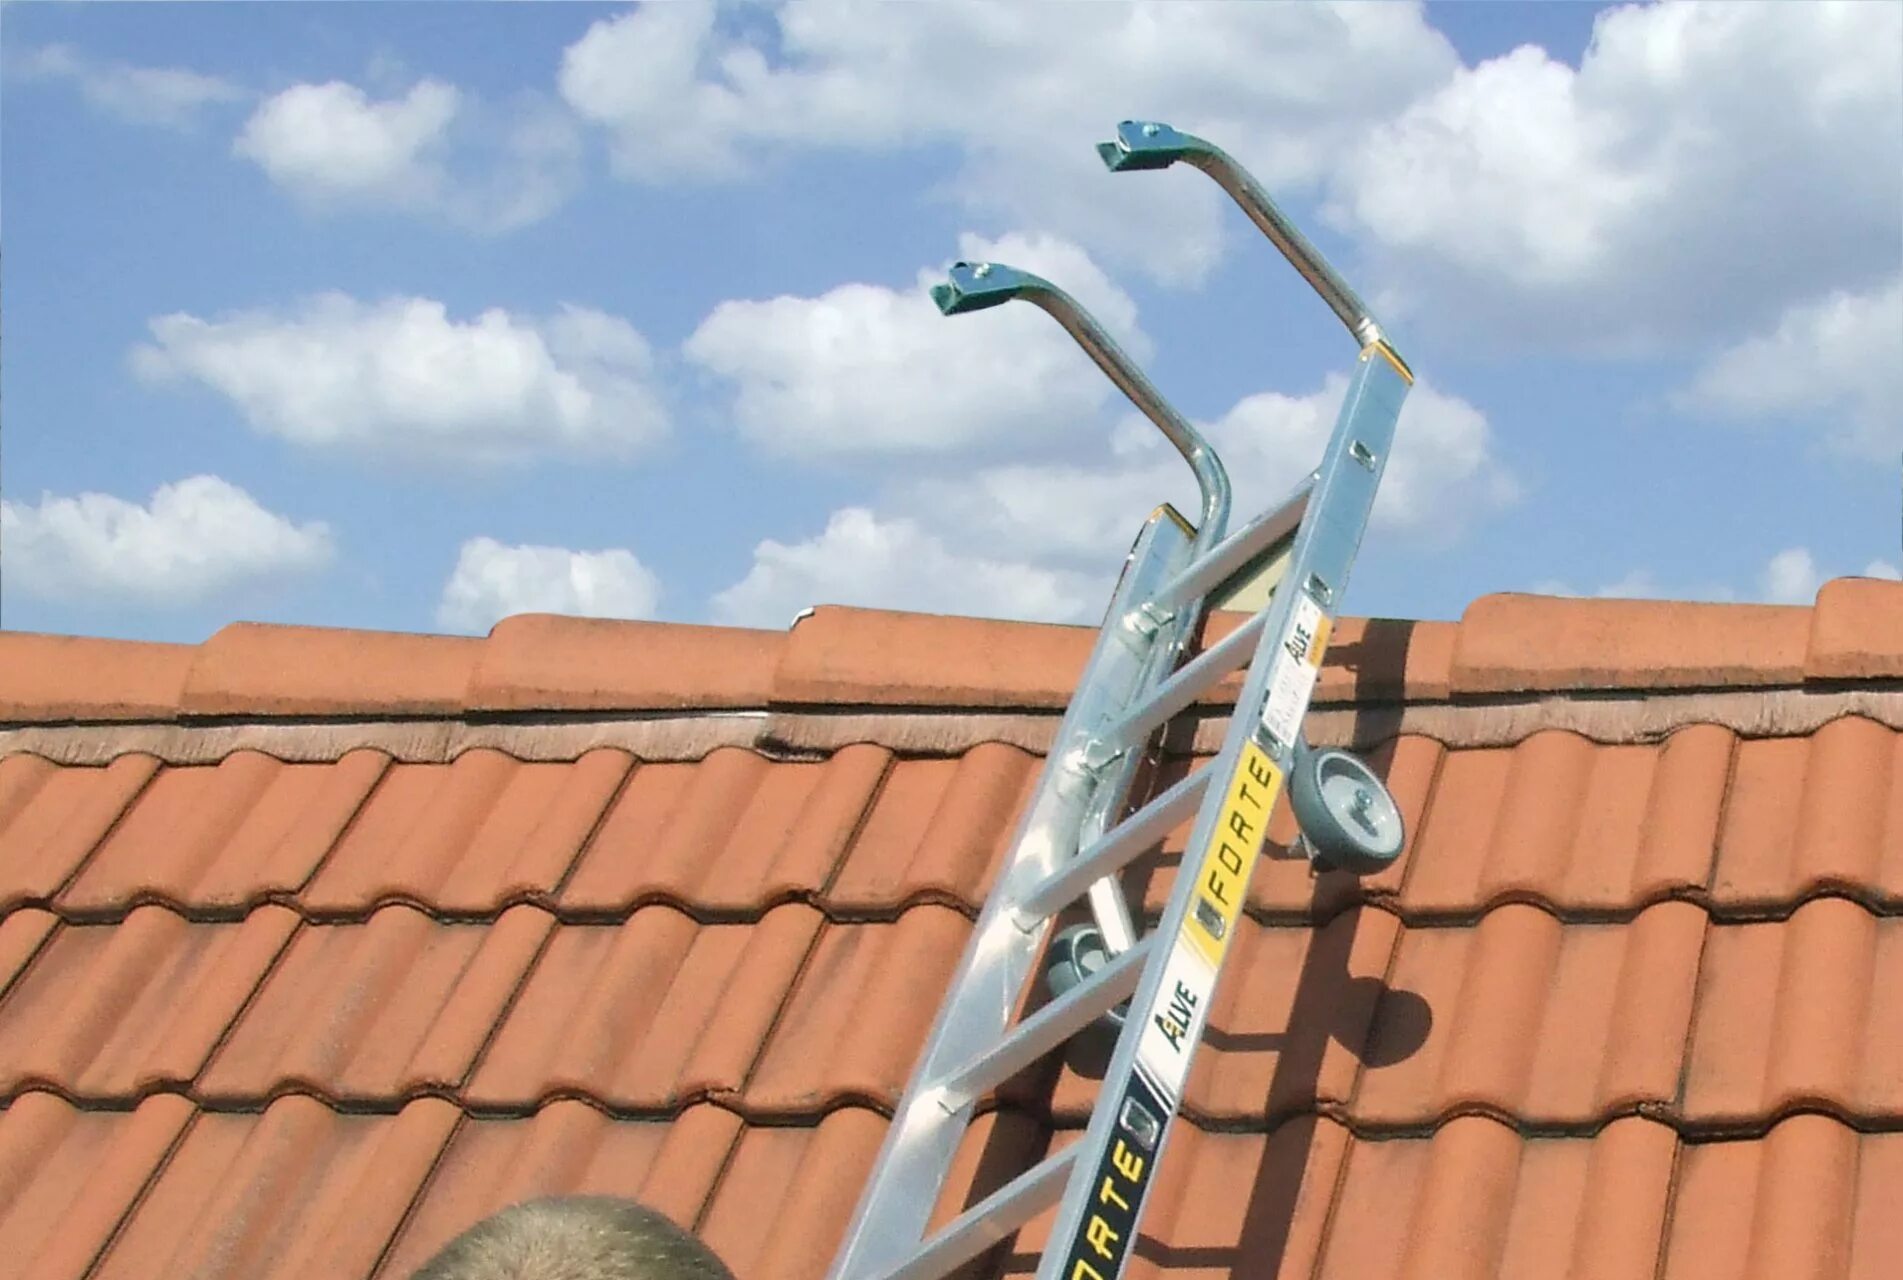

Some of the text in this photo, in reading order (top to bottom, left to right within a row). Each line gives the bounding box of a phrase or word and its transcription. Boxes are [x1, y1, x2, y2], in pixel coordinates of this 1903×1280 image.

[1284, 623, 1312, 666] ALVE
[1207, 755, 1272, 906] FORTE
[1153, 980, 1200, 1054] ALVE
